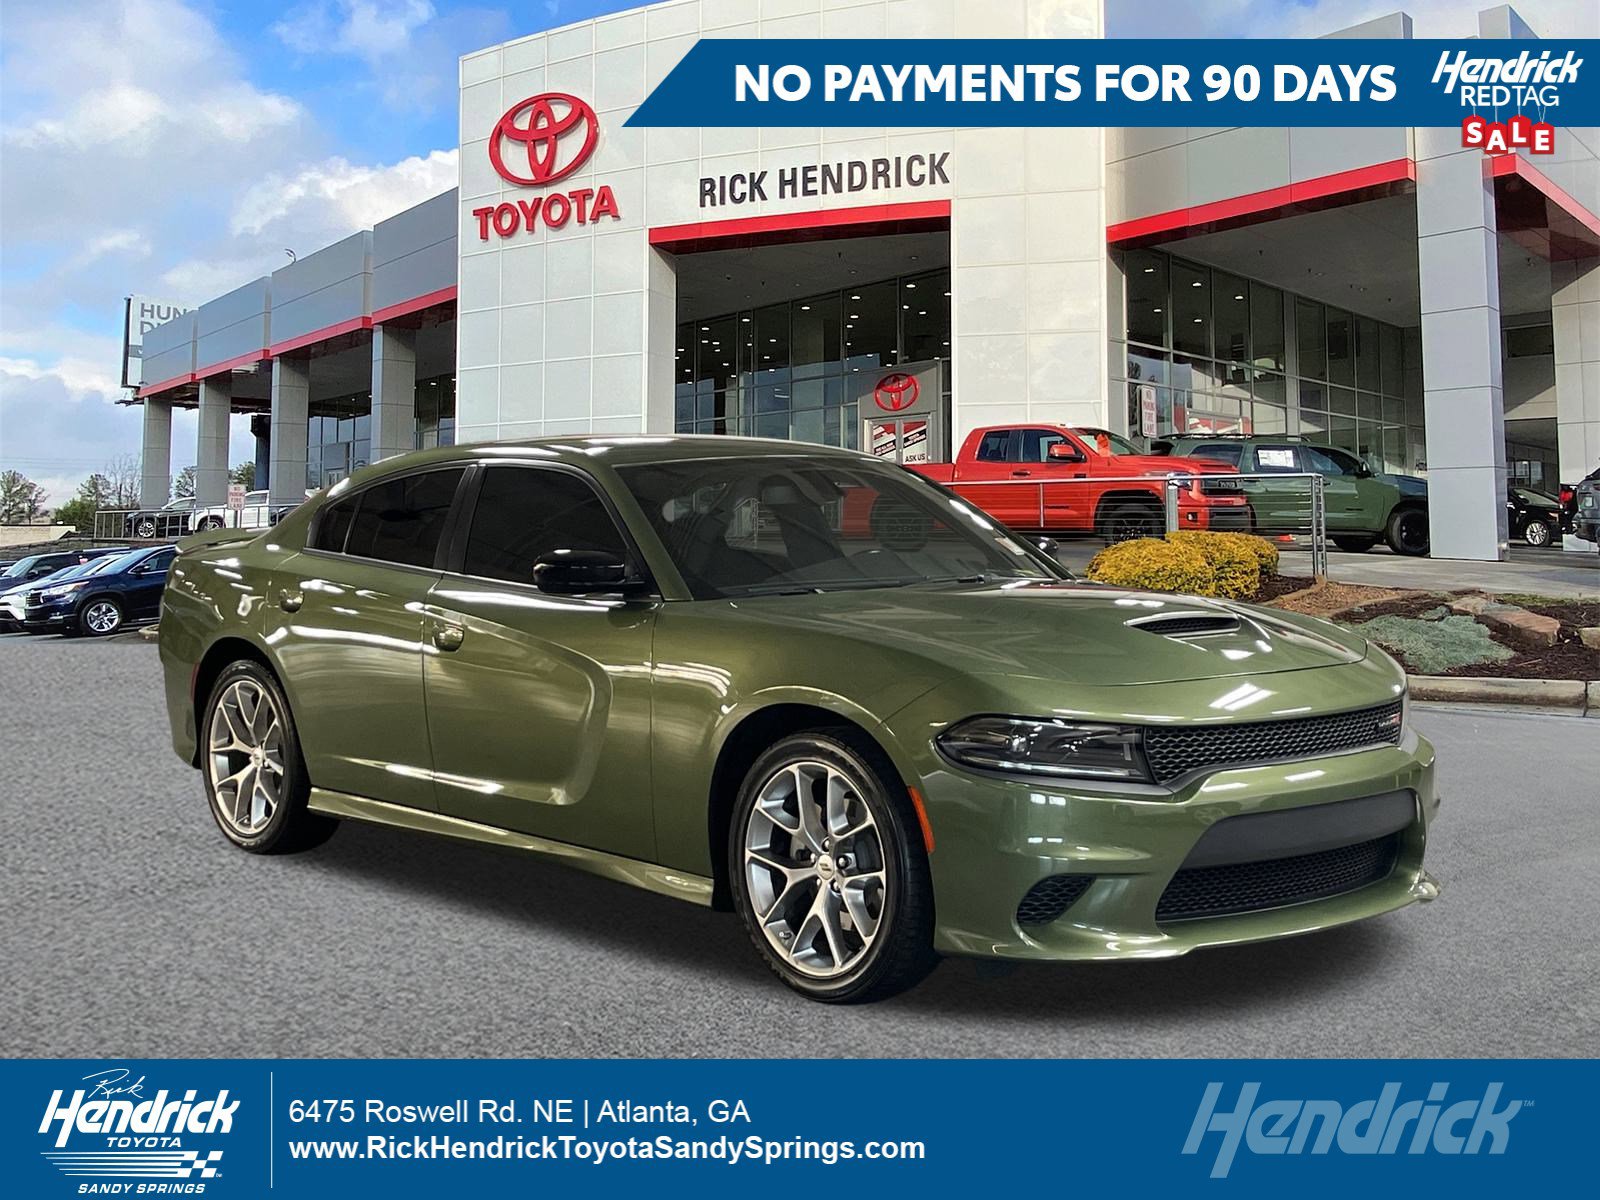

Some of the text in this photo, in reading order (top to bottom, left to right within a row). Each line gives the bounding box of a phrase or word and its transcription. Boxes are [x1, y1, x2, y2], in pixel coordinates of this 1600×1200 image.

[699, 151, 951, 208] RICK HENDRICK
[472, 185, 621, 241] TOYOTA
[904, 453, 926, 463] ASK US
